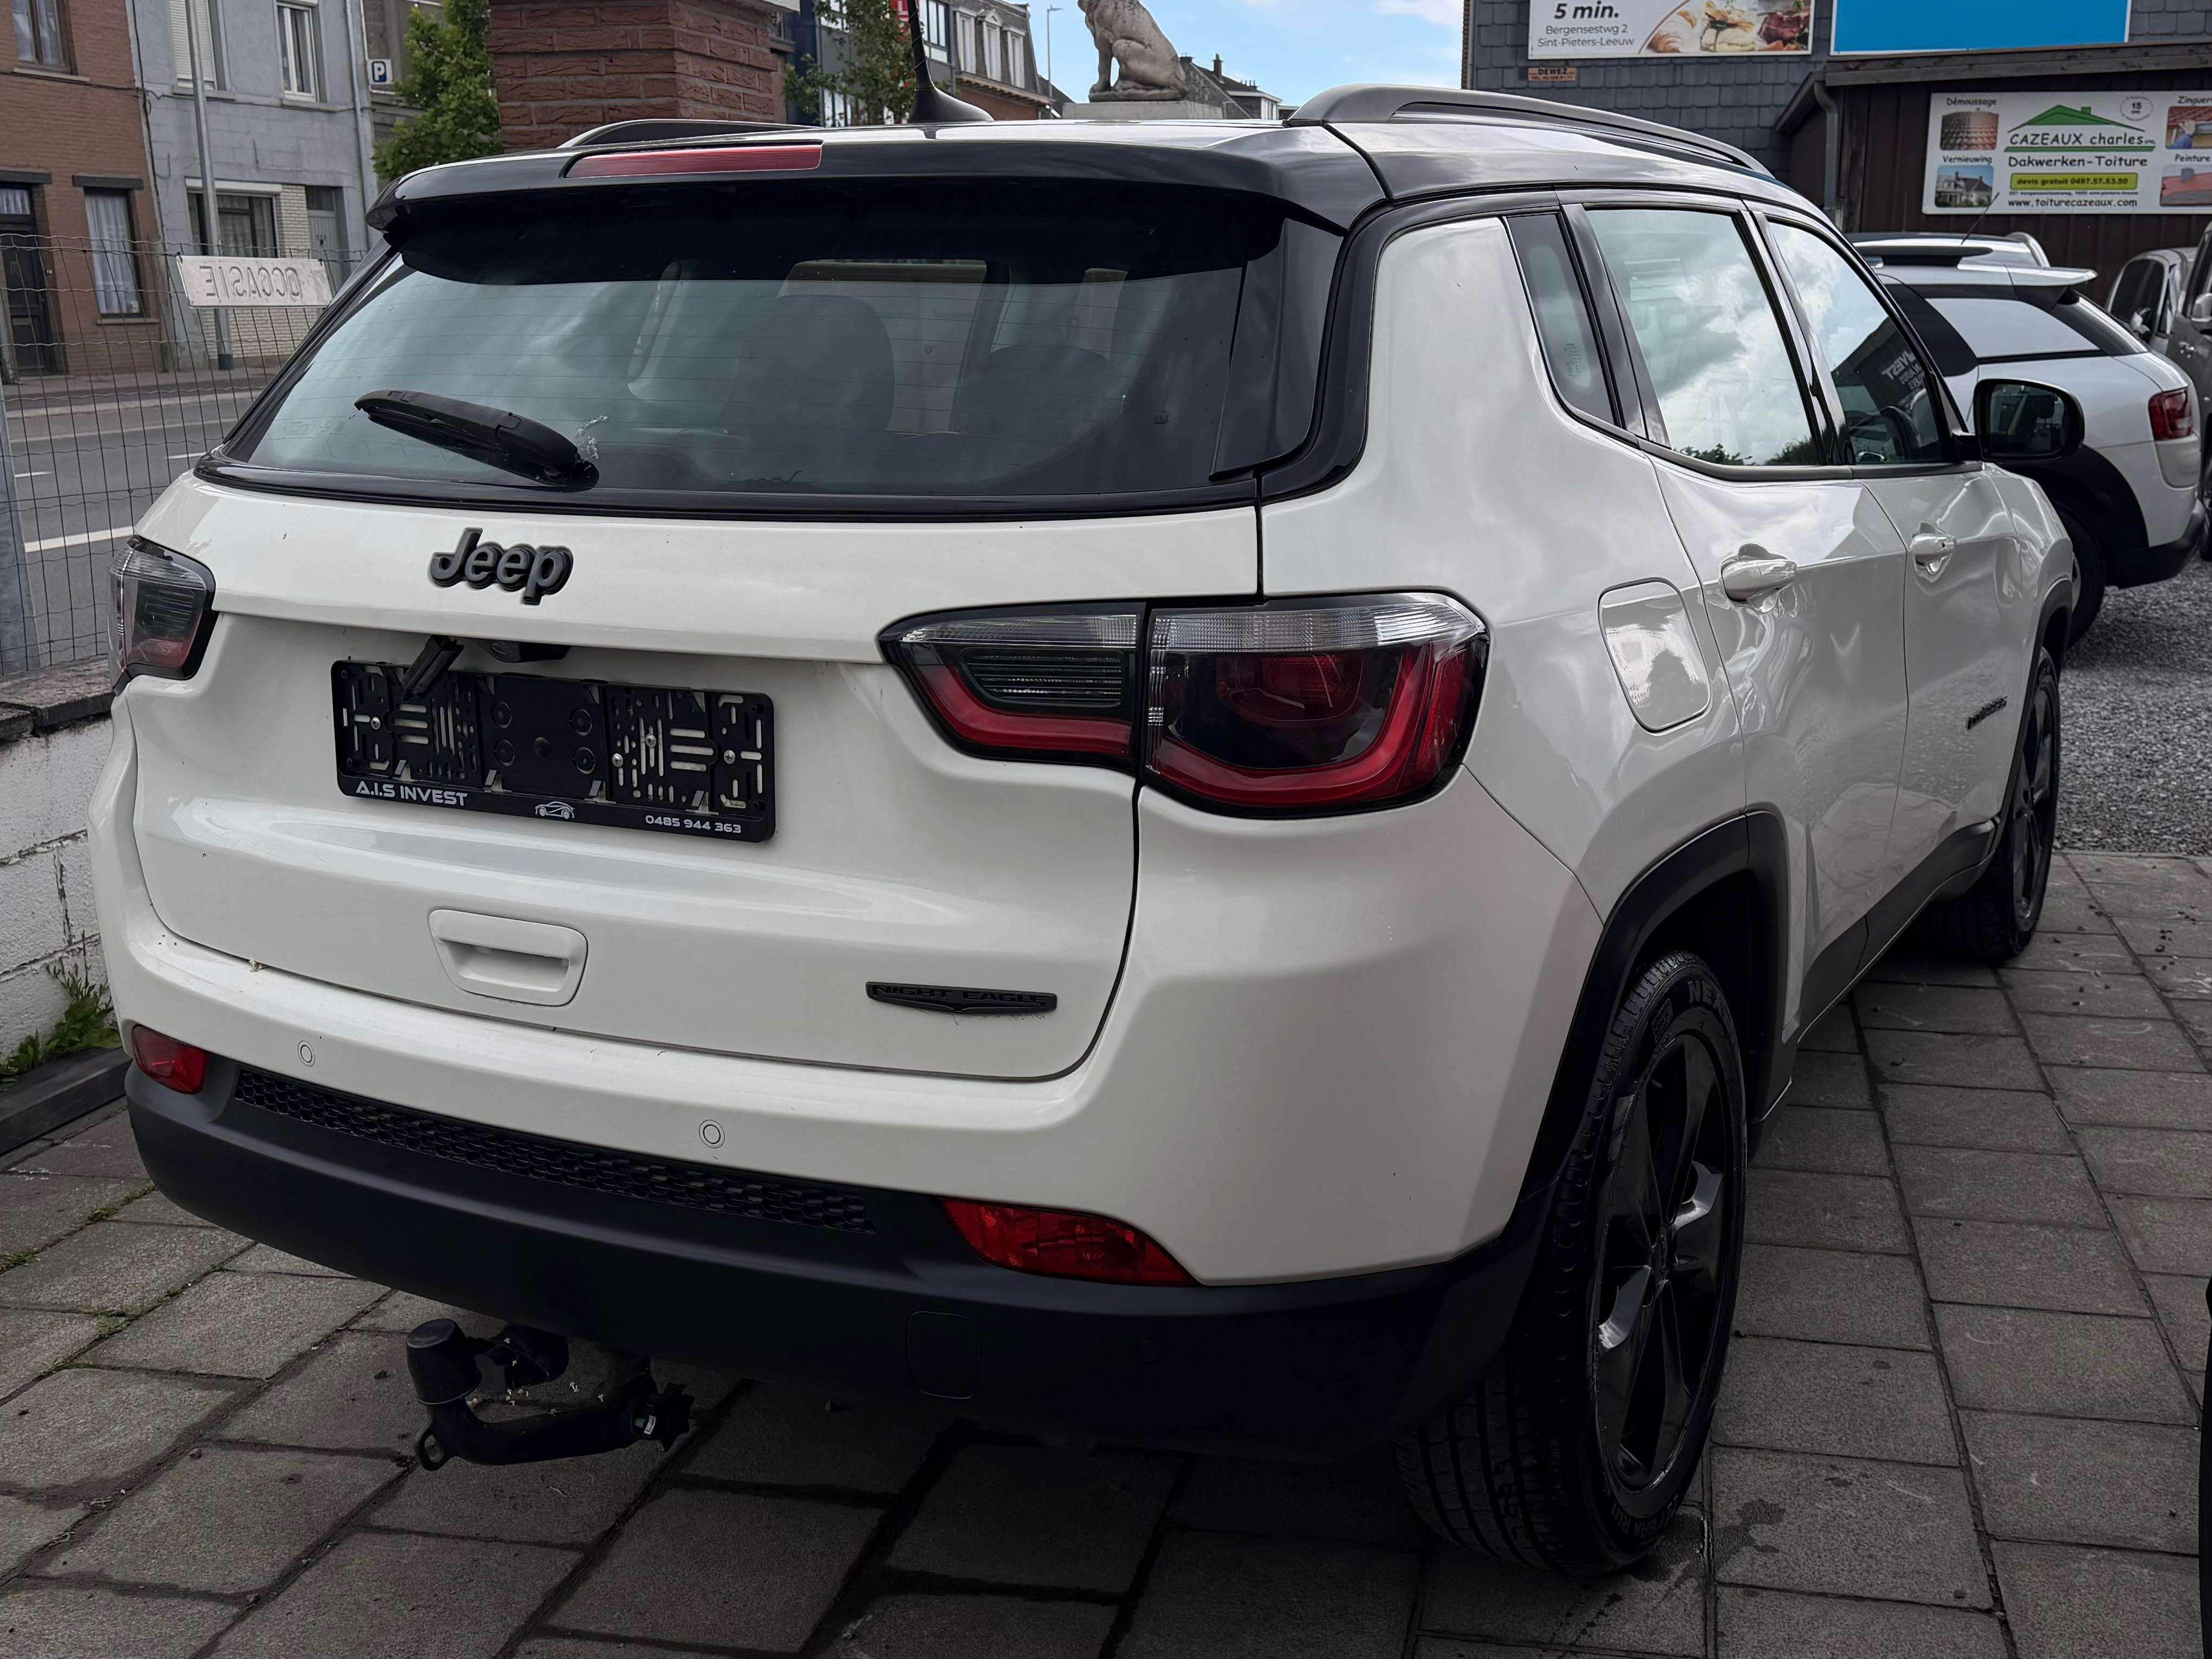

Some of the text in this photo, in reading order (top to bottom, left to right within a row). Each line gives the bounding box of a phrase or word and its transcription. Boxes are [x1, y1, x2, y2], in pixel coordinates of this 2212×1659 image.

[1554, 1, 1619, 19] 5 min.
[1546, 24, 1628, 36] Bergensestwg 2
[1538, 37, 1634, 47] Sint-Pieters-Leeuw
[373, 62, 385, 81] P
[2009, 133, 2083, 145] CAZEAUX
[2090, 132, 2144, 145] charles
[1943, 155, 1993, 165] Vernieuwing
[2175, 153, 2211, 162] Peinture
[2041, 178, 2068, 186] gratuit
[2008, 197, 2138, 208] www.toiturecazeaux.com
[428, 527, 574, 606] Jeep
[355, 780, 468, 806] A.I.S INVEST
[645, 814, 742, 834] 0485 944 363
[872, 984, 1047, 1007] NIGHT EAGLE
